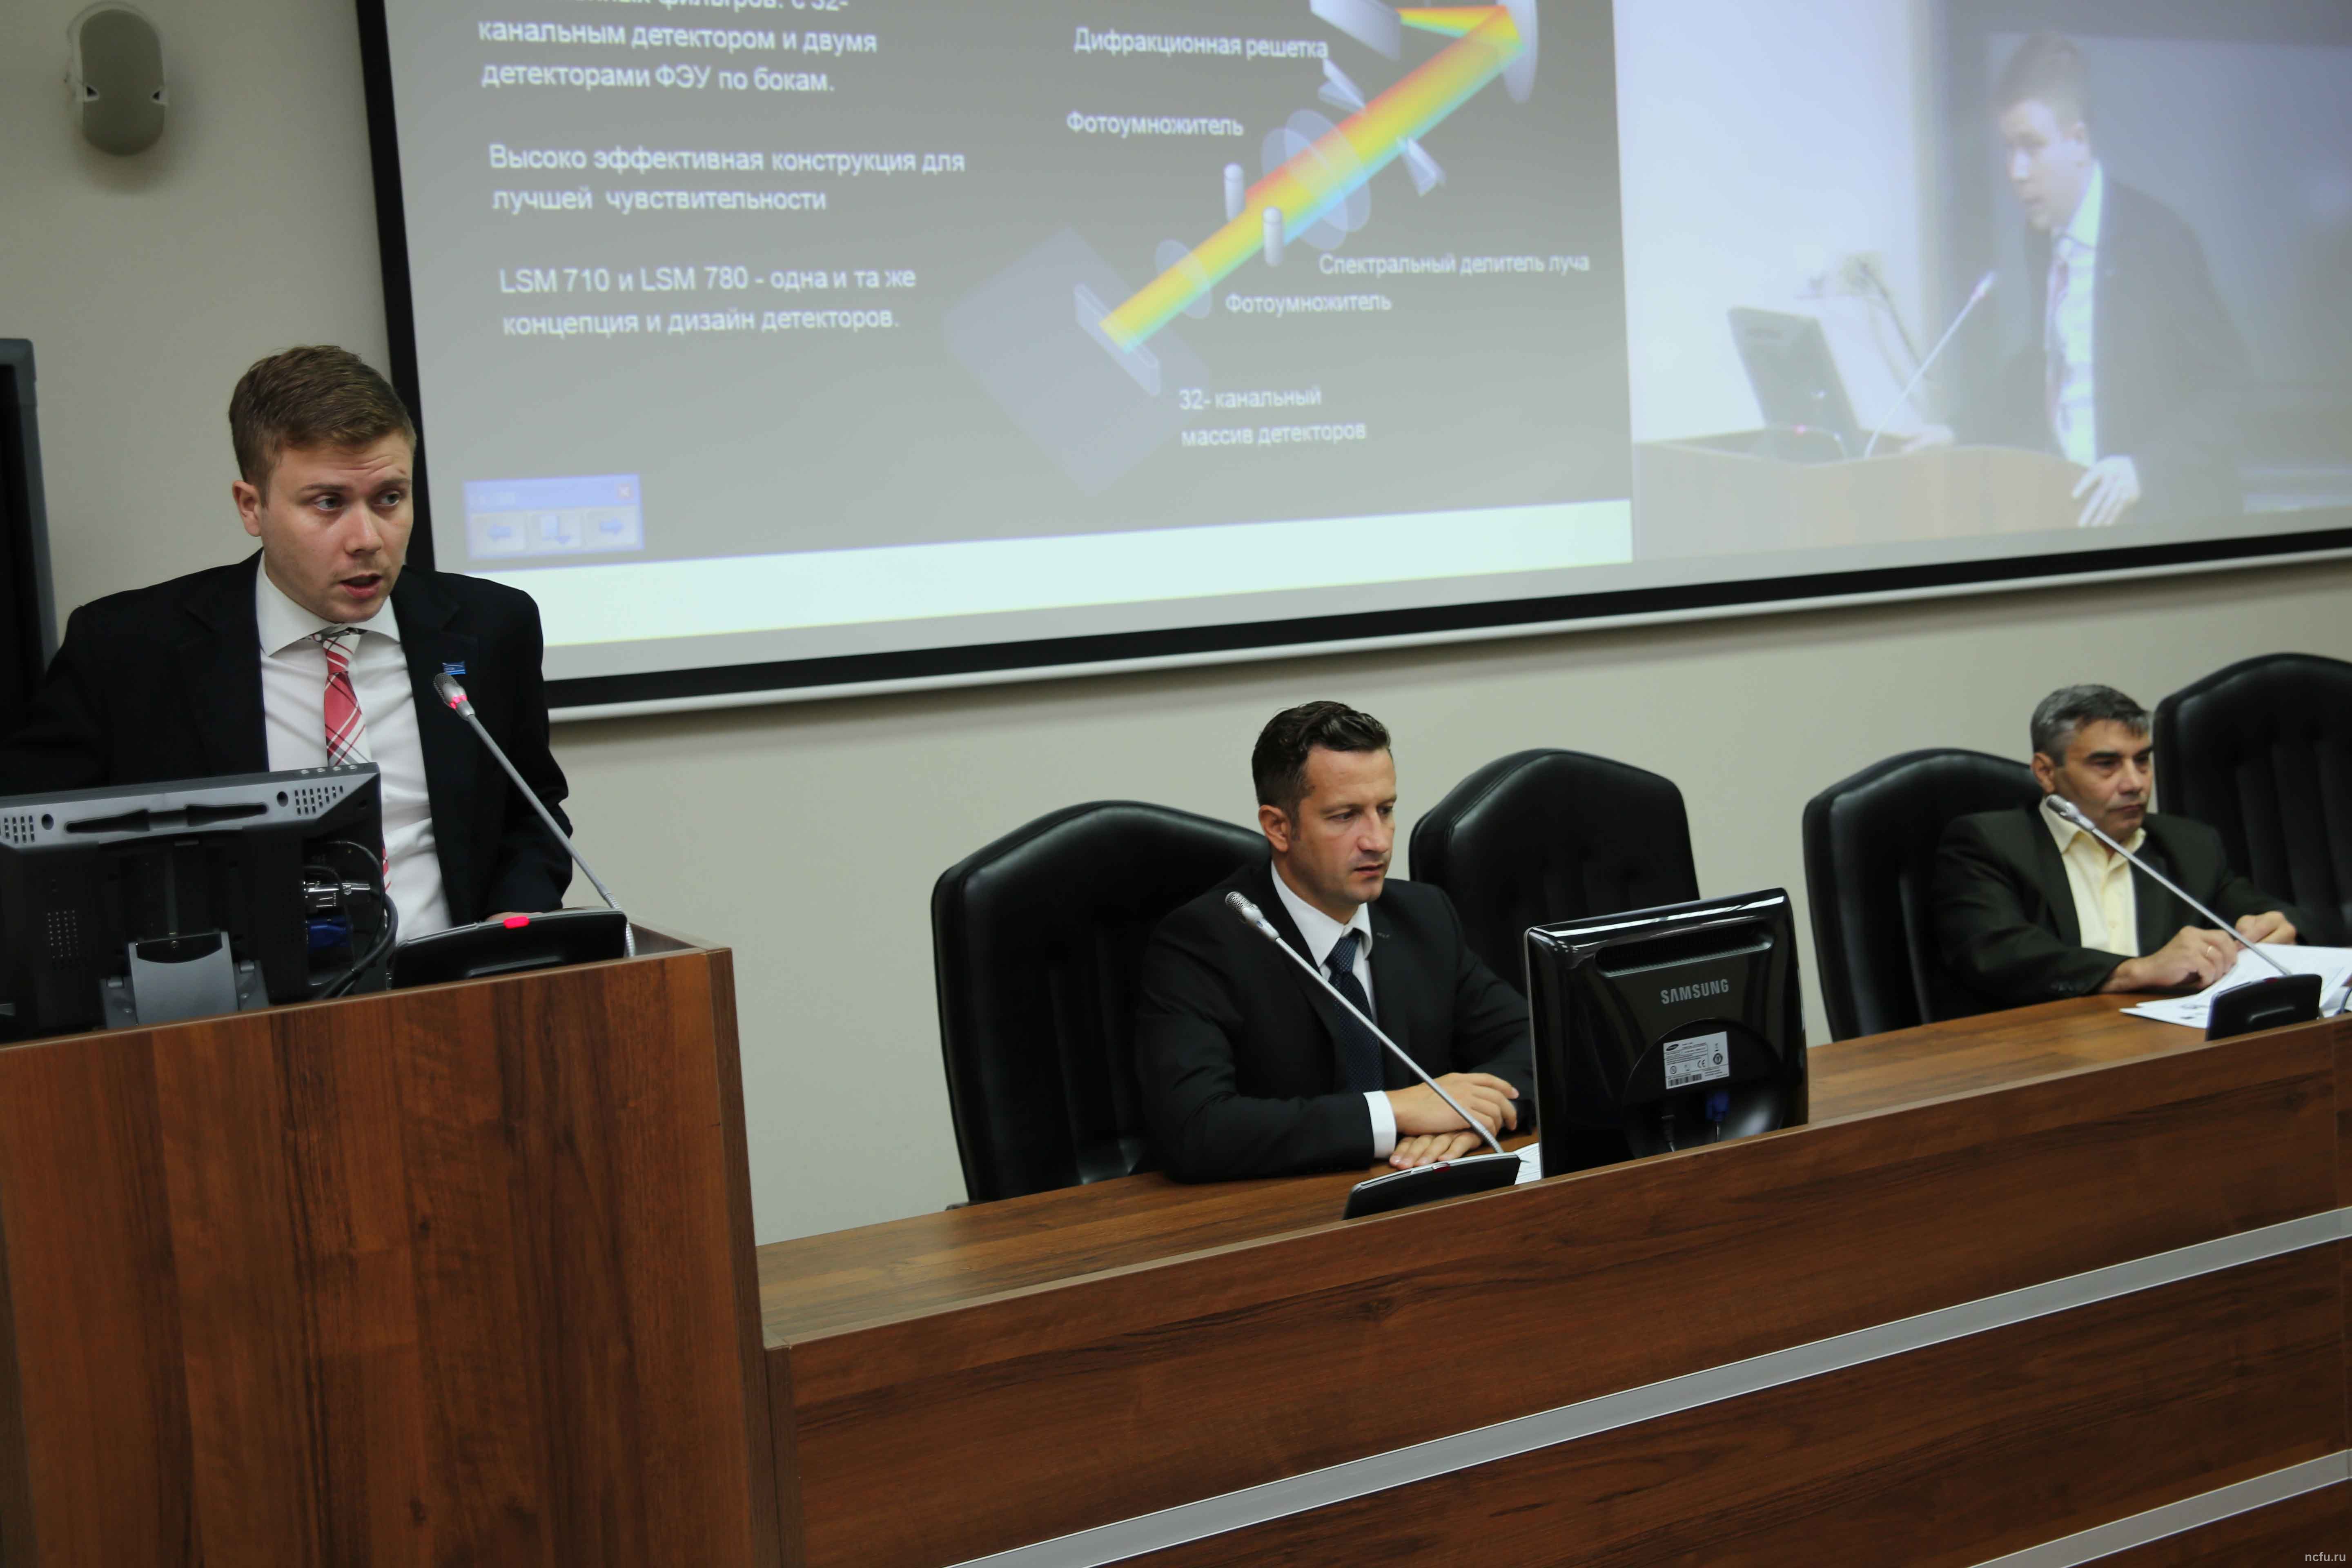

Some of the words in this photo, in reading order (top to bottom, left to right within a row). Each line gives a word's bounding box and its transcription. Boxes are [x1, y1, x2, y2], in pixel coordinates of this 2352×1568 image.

[478, 21, 626, 45] канальным
[631, 26, 775, 54] детектором
[783, 31, 797, 50] и
[803, 31, 877, 56] двумя
[1074, 26, 1241, 57] Дифракционная
[1246, 37, 1328, 60] решетка
[481, 64, 650, 91] детекторами
[655, 64, 711, 89] ФЭУ
[718, 71, 748, 90] по
[754, 65, 834, 91] бокам.
[1067, 110, 1244, 138] Фотоумножитель
[489, 143, 587, 169] Высоко
[594, 145, 764, 175] эффективная
[772, 152, 916, 176] конструкция
[922, 153, 965, 175] для
[492, 186, 592, 214] лучшей
[606, 190, 826, 214] чувствительности
[499, 268, 558, 293] LSM
[564, 268, 610, 292] 710
[618, 273, 633, 291] и
[640, 266, 696, 292] LSM
[704, 265, 748, 289] 780
[770, 270, 829, 292] одна
[833, 271, 847, 289] и
[854, 270, 879, 288] та
[885, 269, 916, 288] же
[1319, 252, 1457, 279] Спектральный
[1459, 255, 1545, 277] делитель
[1548, 255, 1590, 276] луча
[1225, 292, 1392, 318] Фотоумножитель
[503, 314, 639, 339] концепция
[646, 314, 661, 332] и
[668, 306, 755, 335] дизайн
[761, 309, 900, 333] детекторов.
[1179, 388, 1211, 410] 32-
[1215, 385, 1322, 409] канальный
[1181, 426, 1253, 446] массив
[1257, 421, 1366, 446] детекторов
[1660, 979, 1728, 1004] SAMSUNG
